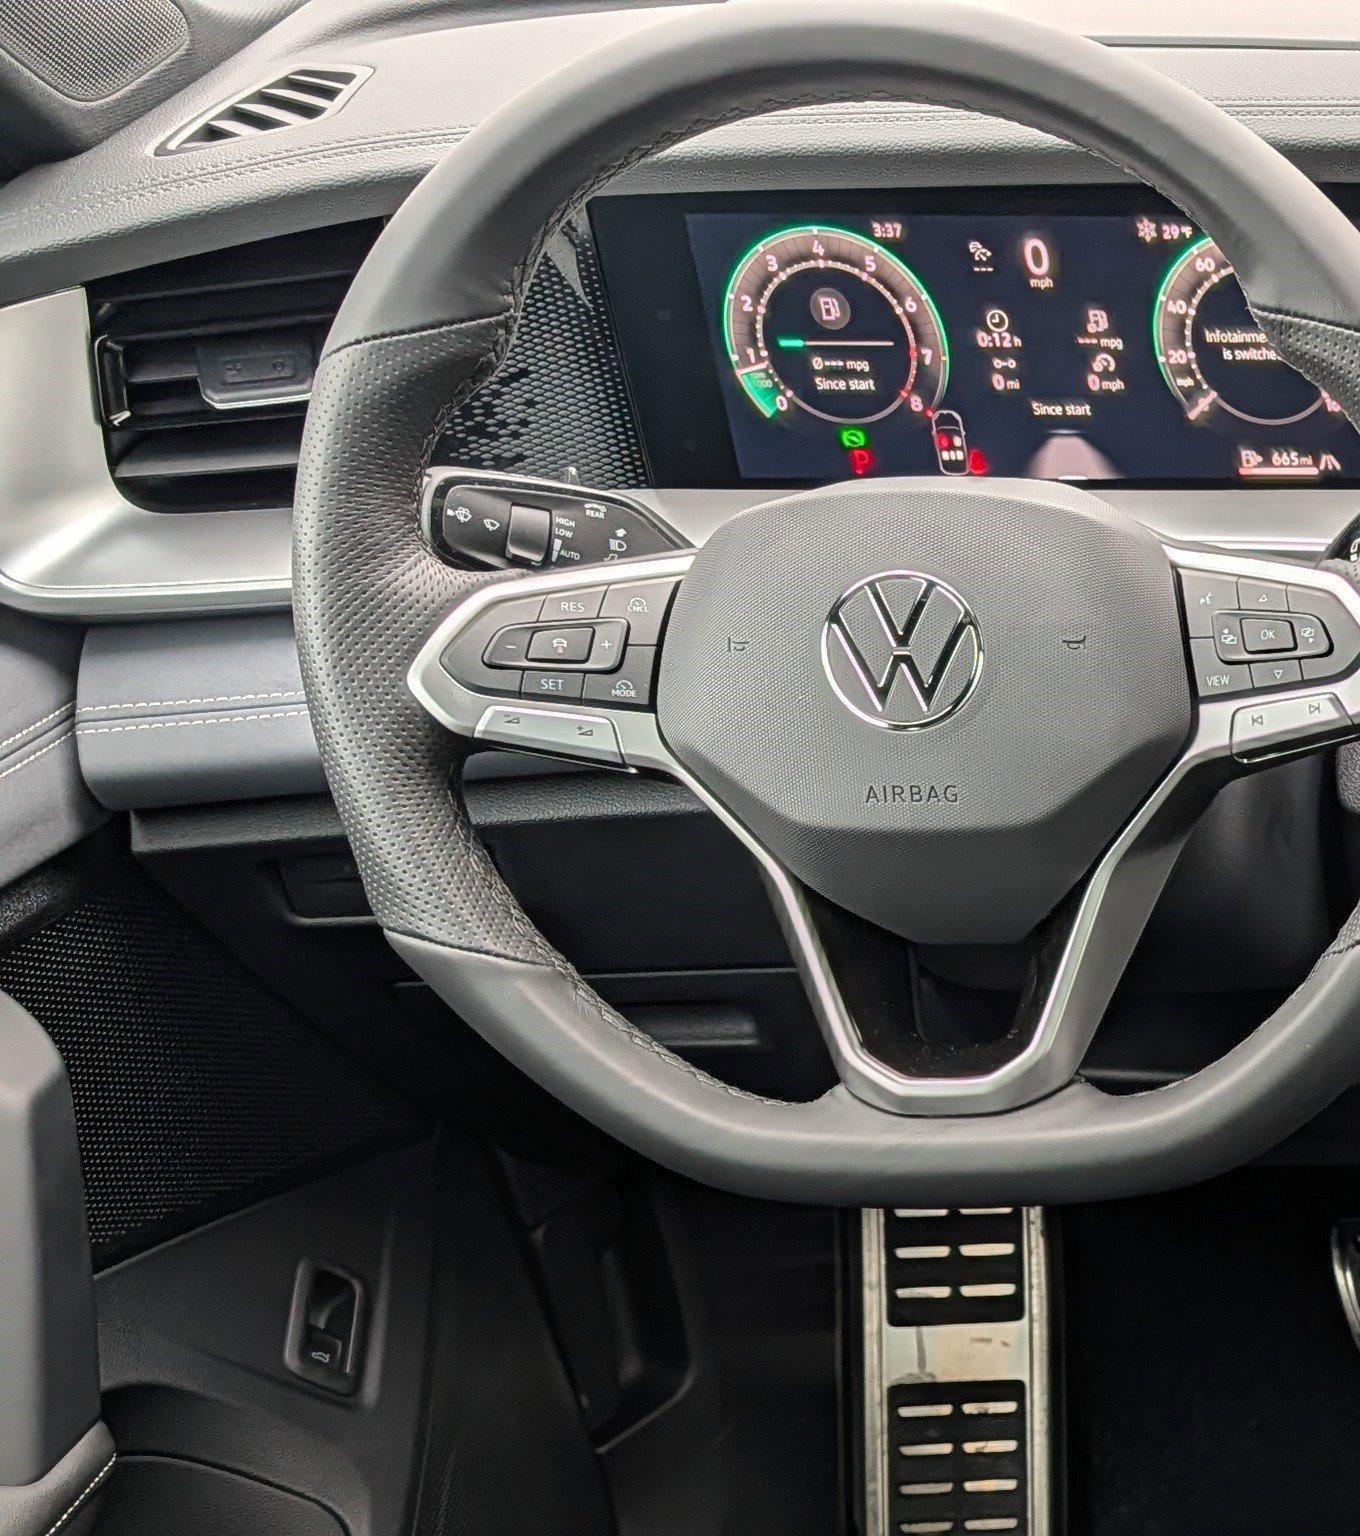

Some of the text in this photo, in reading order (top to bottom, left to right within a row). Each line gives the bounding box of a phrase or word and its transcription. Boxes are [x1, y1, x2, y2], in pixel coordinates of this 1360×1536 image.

[873, 222, 902, 238] 3:37
[1162, 224, 1179, 240] 29
[812, 240, 825, 256] 4
[766, 255, 778, 271] 3
[865, 256, 877, 271] 5
[1023, 238, 1050, 276] 0
[1195, 257, 1215, 272] 60
[1030, 277, 1053, 289] mph
[741, 295, 753, 312] 2
[905, 296, 917, 312] 6
[1167, 300, 1187, 315] 40
[977, 332, 1022, 348] 0:12 h
[1204, 327, 1268, 343] Infotainme
[1100, 337, 1123, 350] mpg
[746, 348, 755, 363] 1
[922, 350, 932, 365] 7
[1168, 350, 1187, 364] 20
[1223, 347, 1280, 360] is switche
[846, 359, 870, 372] mpg
[815, 376, 876, 390] Since start
[992, 374, 1020, 391] 0 mi
[1087, 374, 1125, 394] 0 mph
[776, 395, 788, 411] 0
[910, 396, 923, 412] 8
[1032, 402, 1092, 416] Since start
[1272, 452, 1313, 466] 665 mi
[556, 516, 576, 528] HIGH
[585, 509, 606, 521] REAR
[555, 527, 574, 539] LOW
[560, 550, 581, 561] AUTO
[561, 601, 585, 613] RES
[627, 602, 649, 614] CNCL
[1260, 628, 1276, 641] OK
[540, 679, 563, 690] SET
[1206, 674, 1231, 687] VIEW
[611, 688, 637, 698] MODE
[865, 785, 959, 804] AIRBAG
